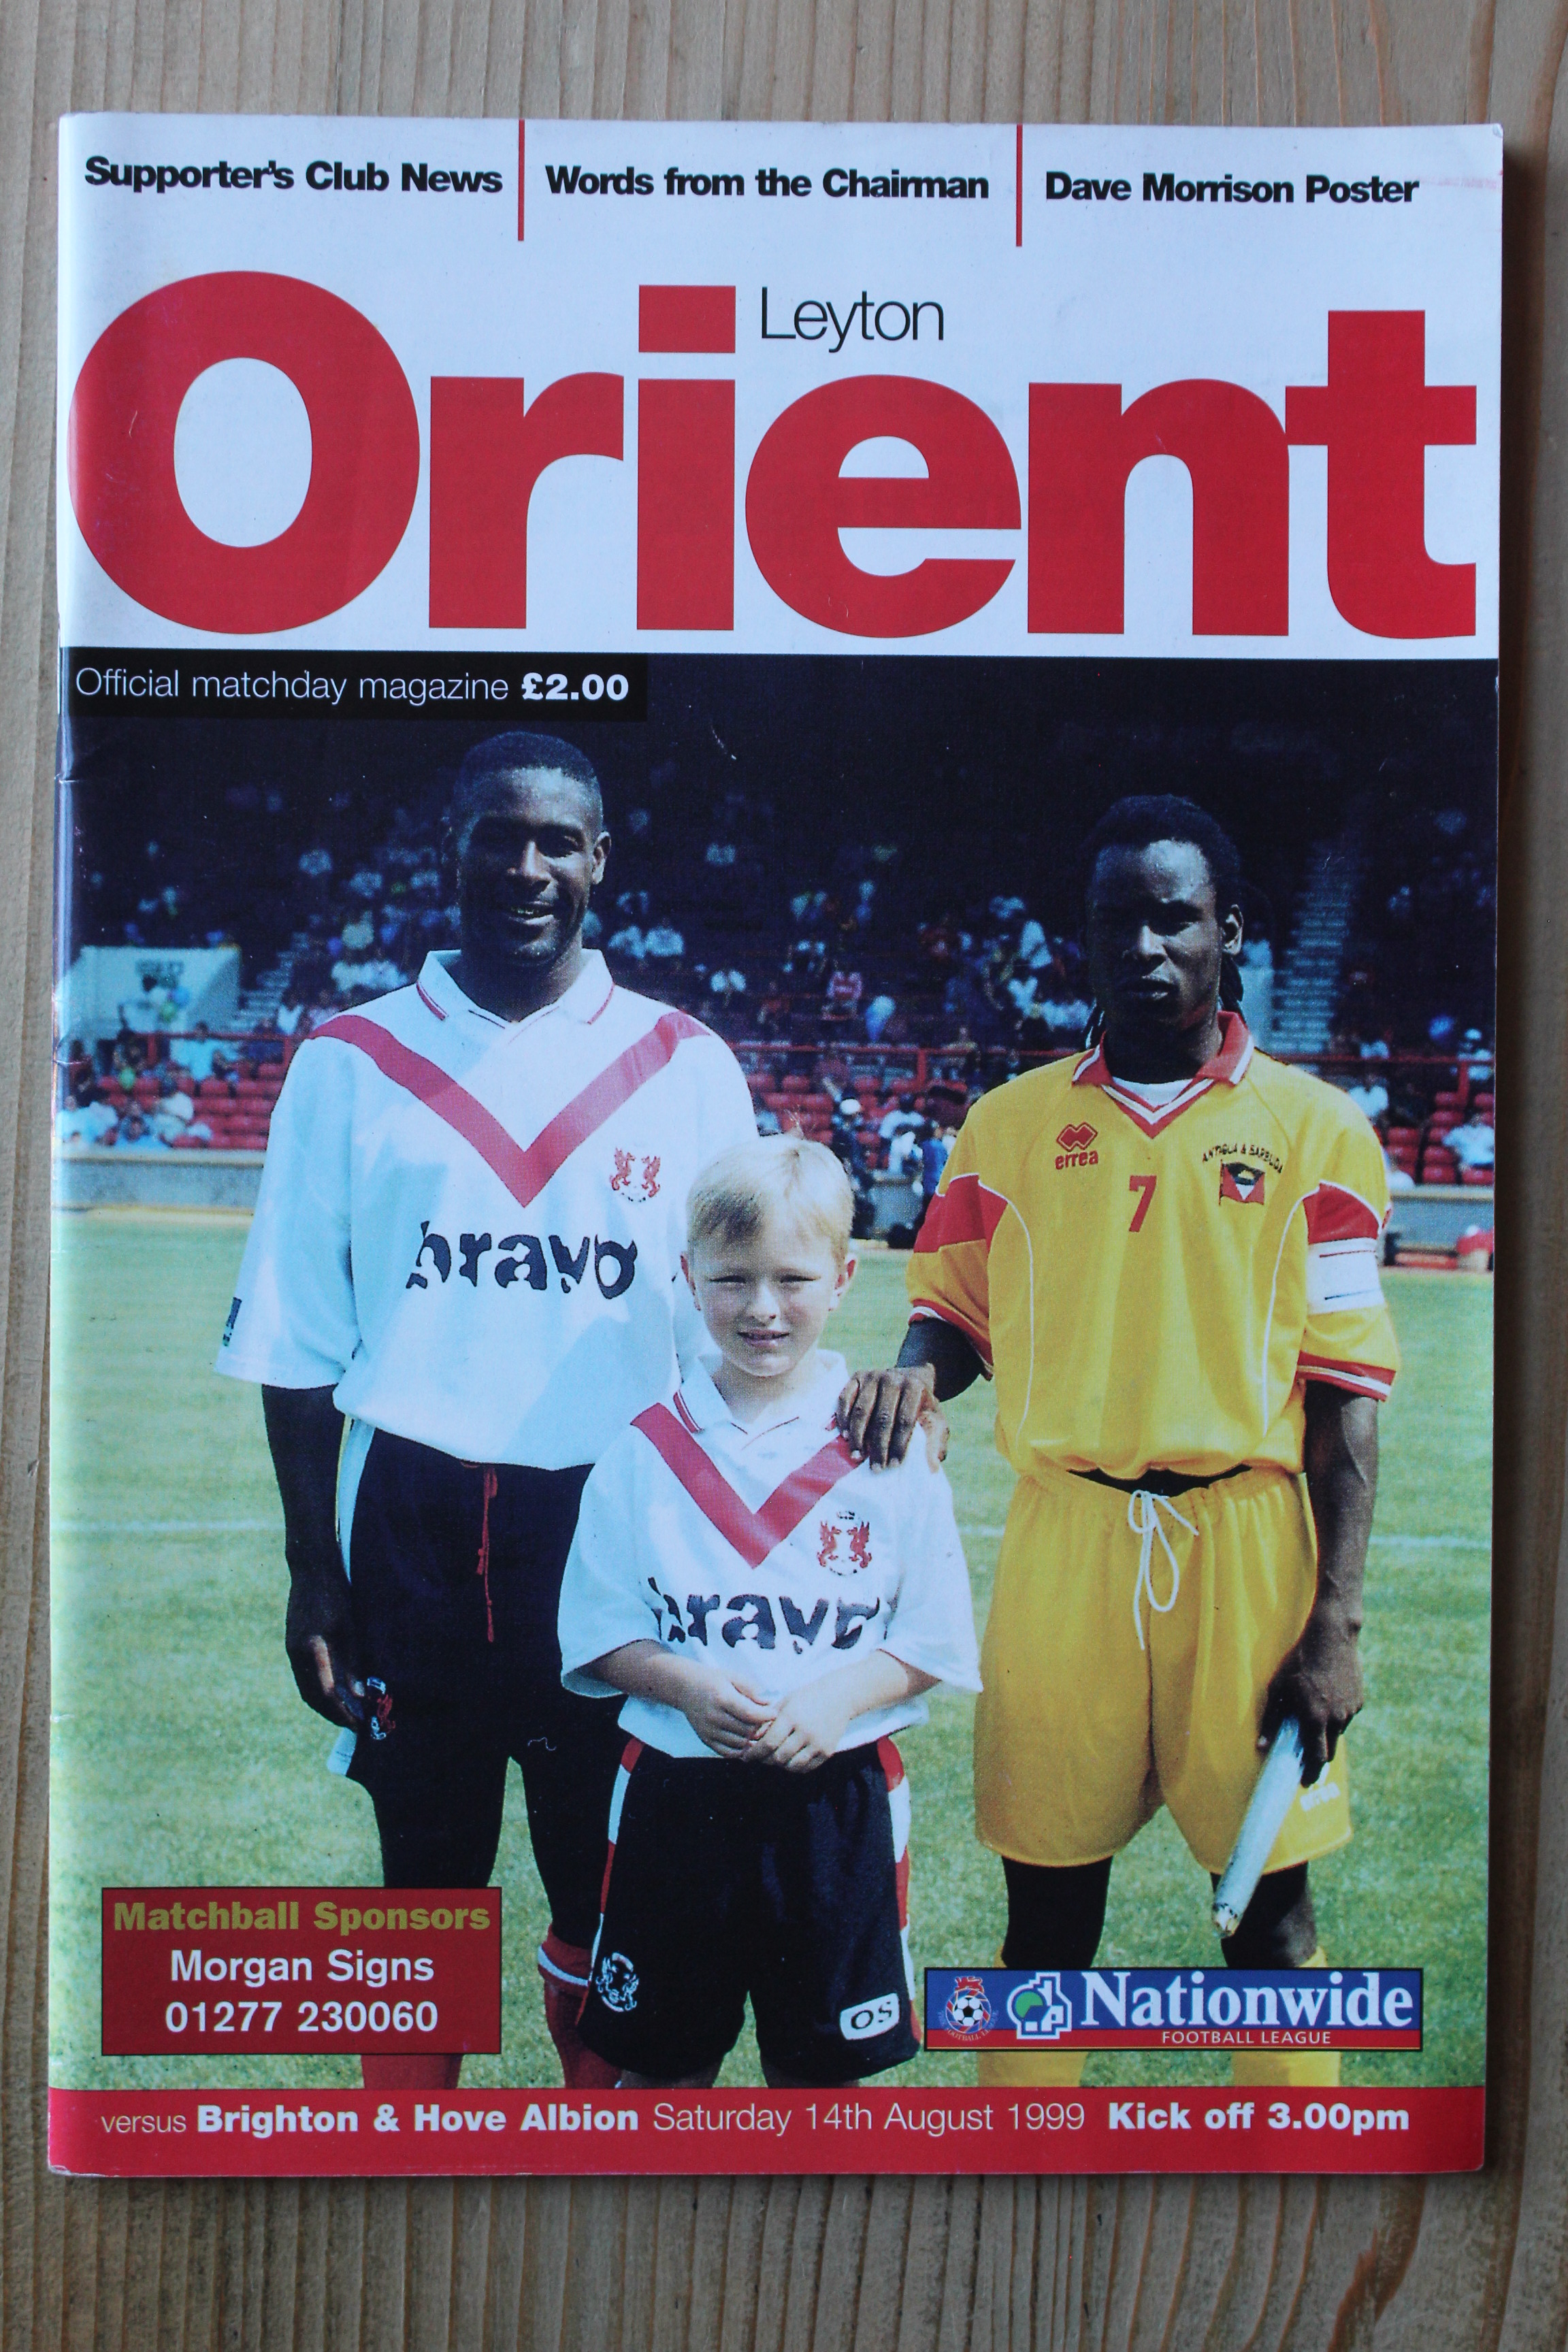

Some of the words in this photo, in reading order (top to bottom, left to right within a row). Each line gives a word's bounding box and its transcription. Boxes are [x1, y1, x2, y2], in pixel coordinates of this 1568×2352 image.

[84, 156, 295, 194] Supporter's
[306, 161, 390, 191] Club
[402, 163, 503, 193] News
[544, 165, 655, 195] Words
[664, 167, 745, 196] from
[755, 167, 812, 197] the
[822, 168, 989, 199] Chairman
[1046, 171, 1132, 201] Dave
[1143, 172, 1294, 203] Morrison
[1306, 174, 1420, 203] Poster
[761, 287, 945, 353] Leyton
[67, 270, 1477, 639] Orient
[75, 667, 178, 698] Official
[193, 670, 347, 705] matchday
[359, 672, 509, 706] magazine
[521, 672, 629, 701] £2.00
[1055, 1149, 1099, 1171] errea
[1128, 1169, 1158, 1232] 7
[406, 1220, 638, 1299] bravo
[114, 1901, 299, 1931] Matchball
[313, 1901, 491, 1936] Sponsors
[171, 1949, 312, 1988] Morgan
[327, 1948, 434, 1988] Signs
[165, 2001, 282, 2033] 01277
[297, 2001, 438, 2033] 230060
[1080, 1970, 1414, 2027] Nationwide
[1162, 2030, 1254, 2044] FOOTBALL
[1261, 2030, 1331, 2044] LEAGUE
[100, 2114, 187, 2134] versus
[197, 2104, 359, 2139] Brighton
[373, 2103, 401, 2133] &
[414, 2104, 507, 2132] Hove
[519, 2103, 639, 2132] Albion
[653, 2102, 792, 2137] Saturday
[805, 2102, 872, 2130] 14th
[883, 2102, 994, 2138] August
[1008, 2102, 1085, 2131] 1999
[1108, 2102, 1192, 2130] Kick
[1204, 2102, 1255, 2130] off
[1267, 2102, 1409, 2136] 3.00pm
